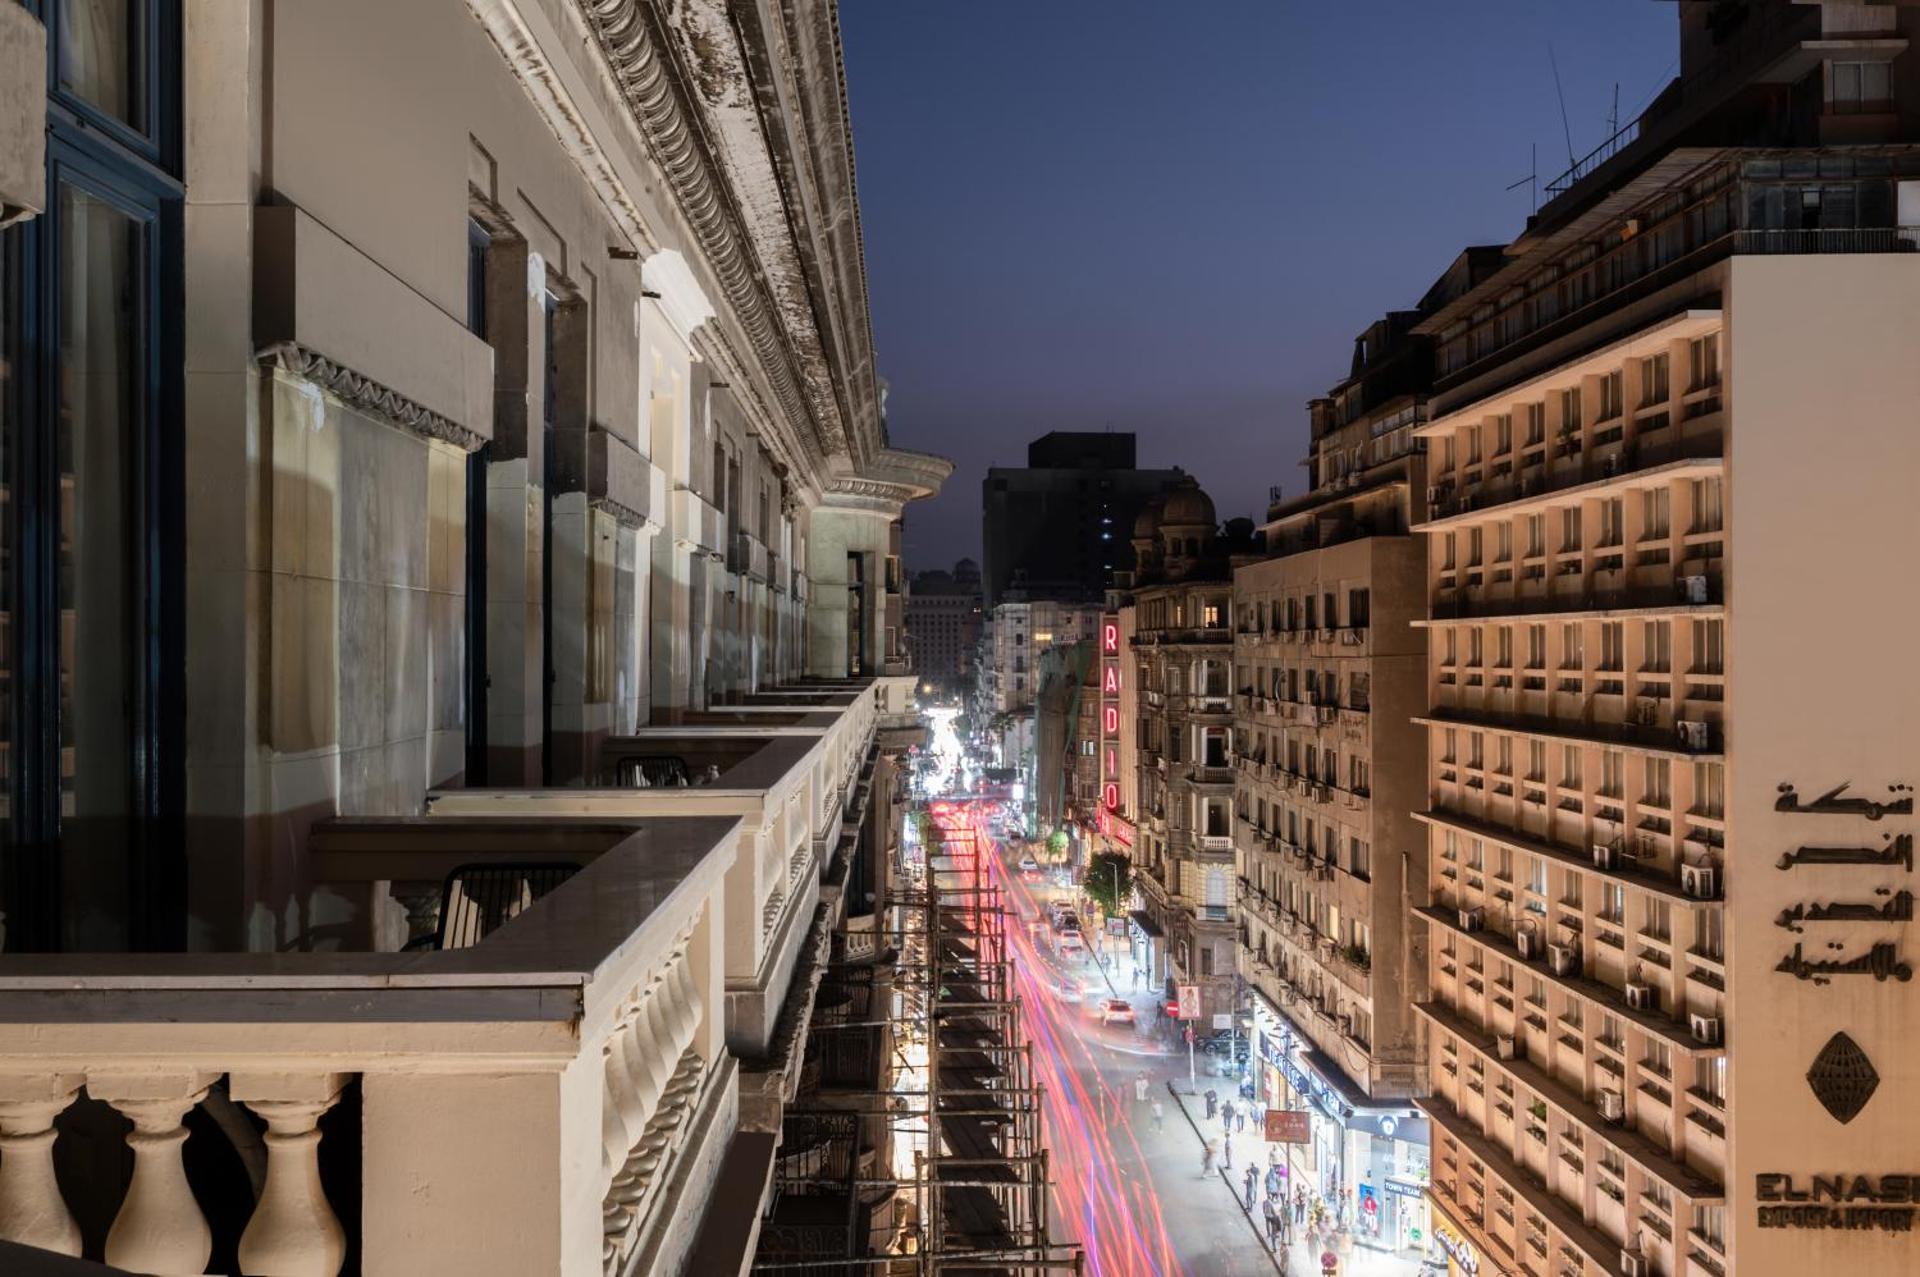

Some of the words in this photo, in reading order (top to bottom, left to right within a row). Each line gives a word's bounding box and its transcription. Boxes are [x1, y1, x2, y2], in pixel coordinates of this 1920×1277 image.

[1105, 625, 1117, 809] RADIO
[1775, 781, 1913, 820] شركة
[1775, 833, 1913, 872] النصر
[1385, 1182, 1402, 1193] TOWN
[1403, 1186, 1420, 1197] TEAM
[1757, 1206, 1829, 1229] EXPORT
[1845, 1207, 1913, 1232] IMPORT
